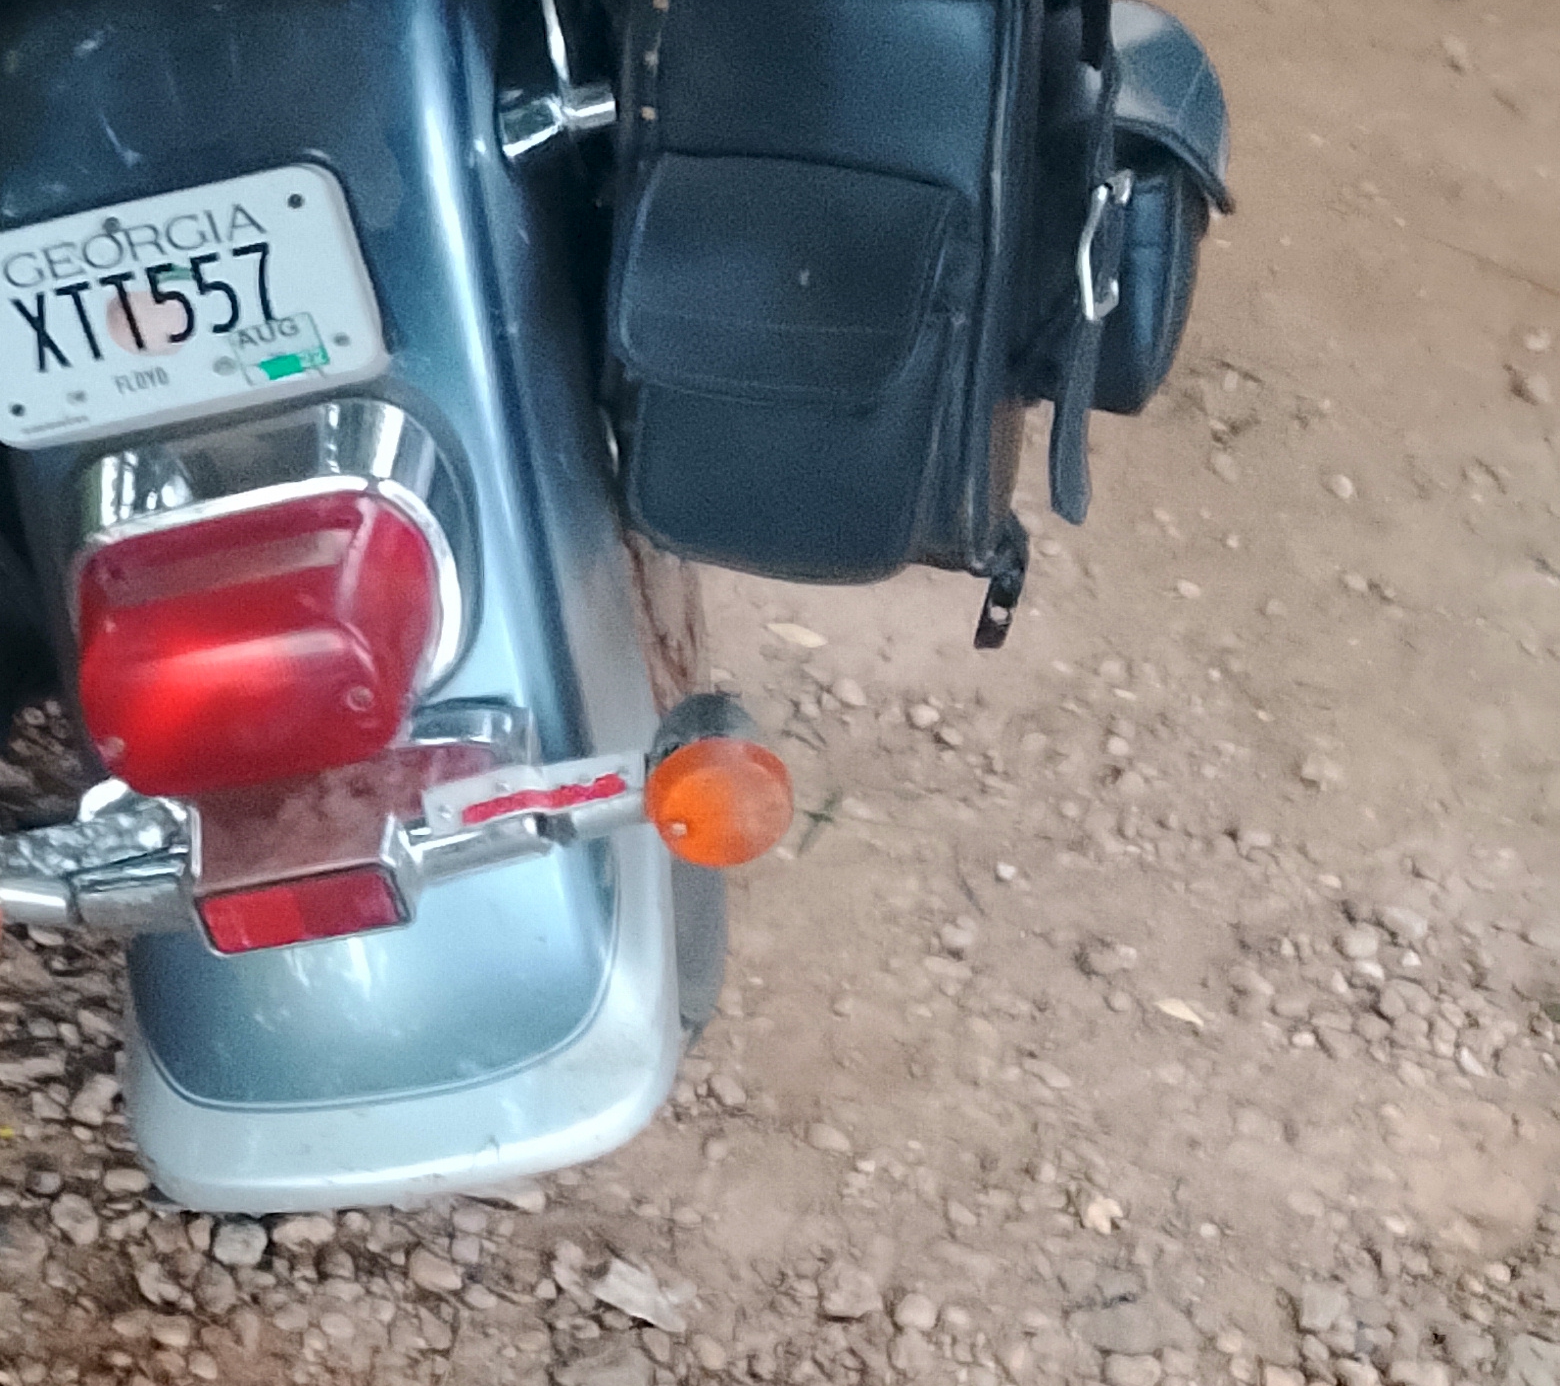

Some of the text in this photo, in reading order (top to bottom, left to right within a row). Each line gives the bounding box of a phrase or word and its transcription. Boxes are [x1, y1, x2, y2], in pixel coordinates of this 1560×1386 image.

[2, 203, 267, 289] GEORGIA
[11, 241, 275, 373] XTT557
[238, 316, 299, 349] AUG
[113, 366, 170, 395] FLOYD
